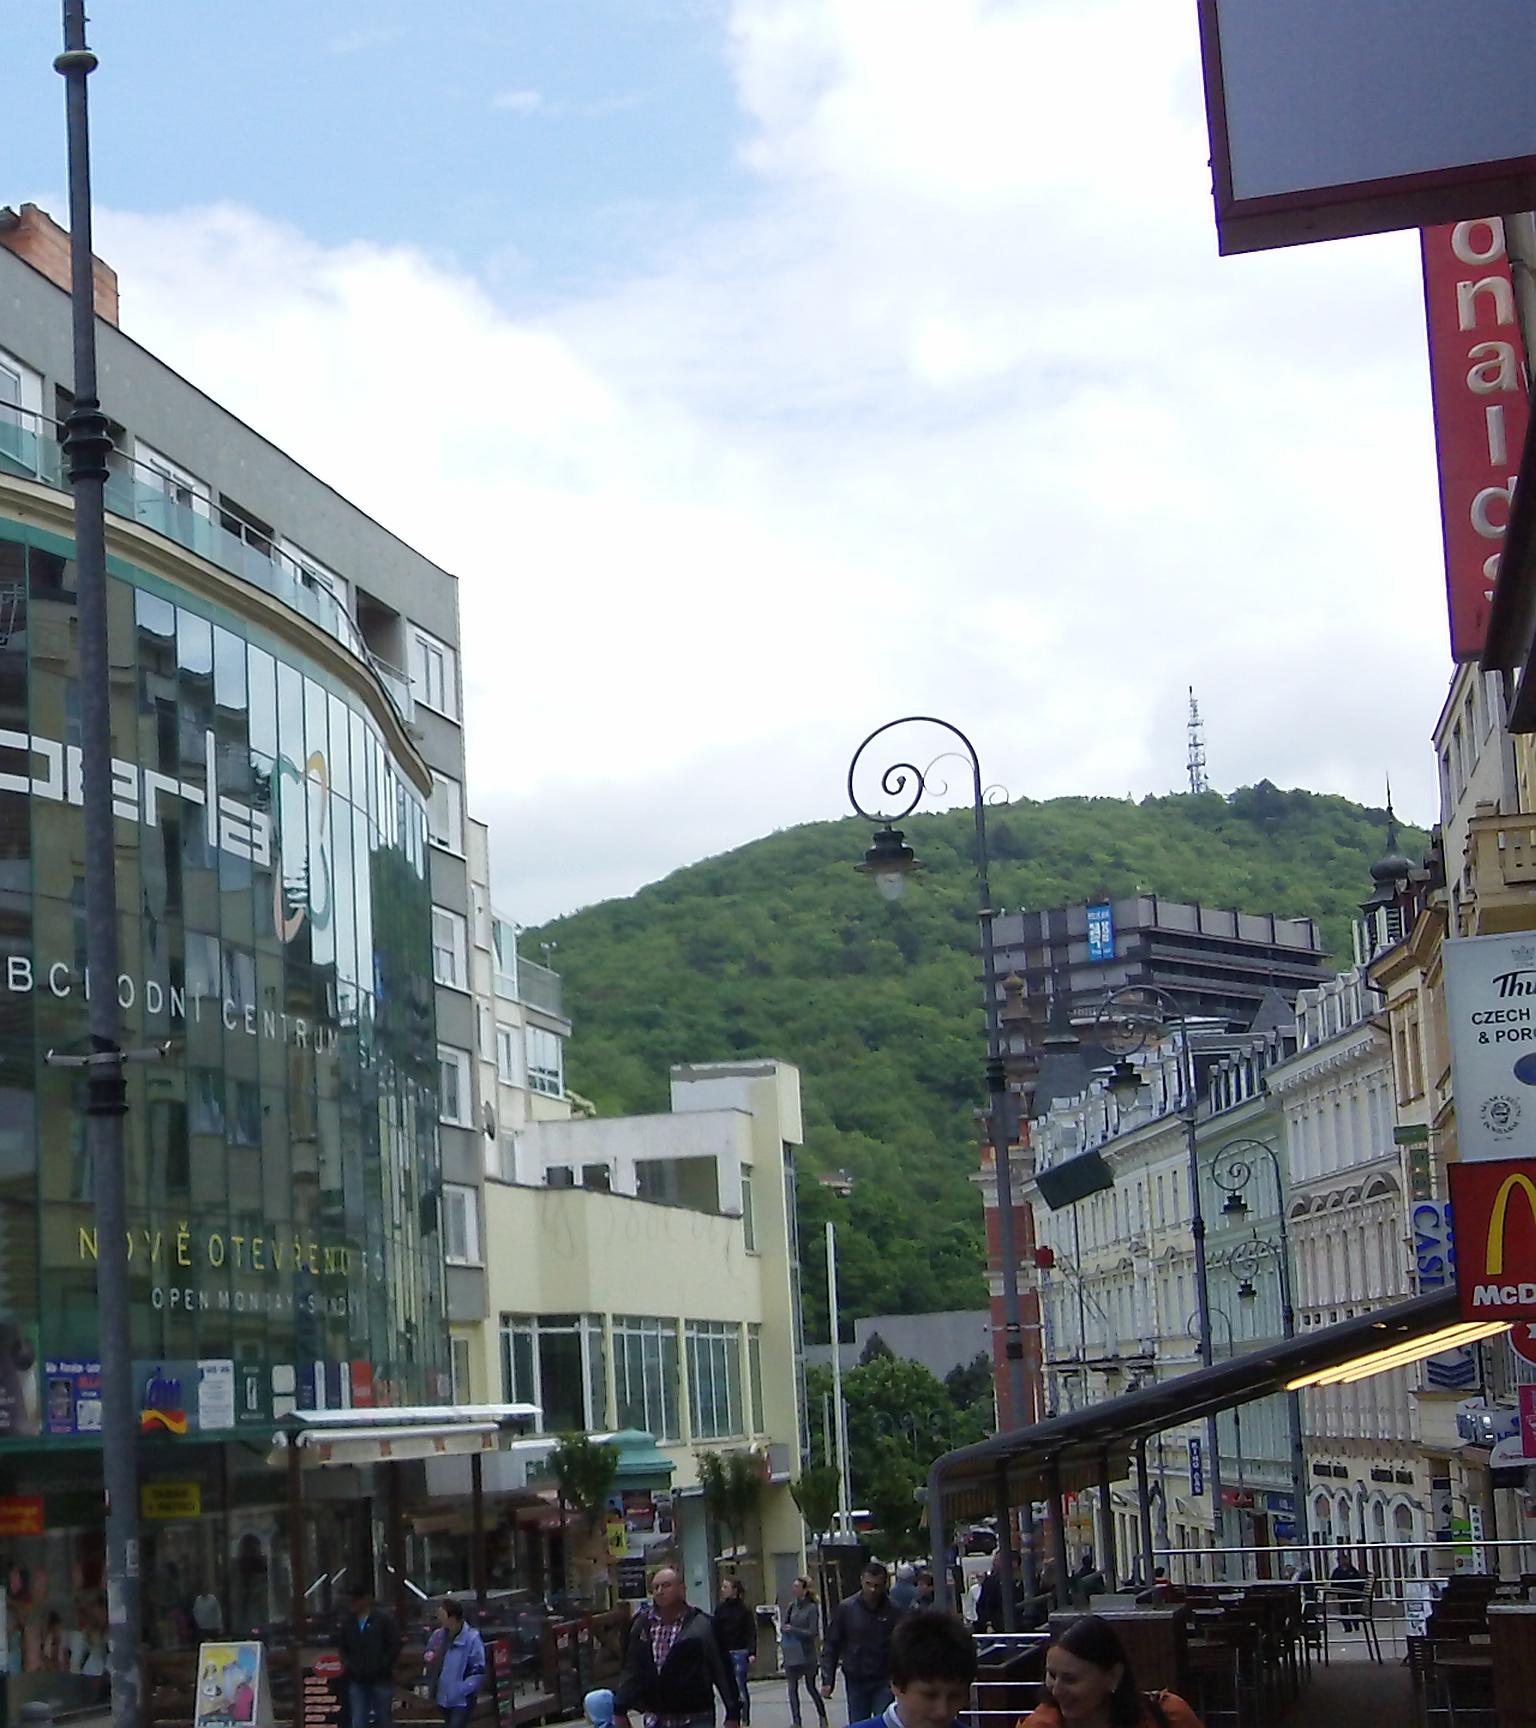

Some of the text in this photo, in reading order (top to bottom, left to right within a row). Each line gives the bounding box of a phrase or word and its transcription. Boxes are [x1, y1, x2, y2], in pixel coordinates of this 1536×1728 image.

[1471, 1008, 1530, 1025] CZECH
[1478, 1027, 1536, 1044] & POR
[152, 1287, 209, 1312] OPEN
